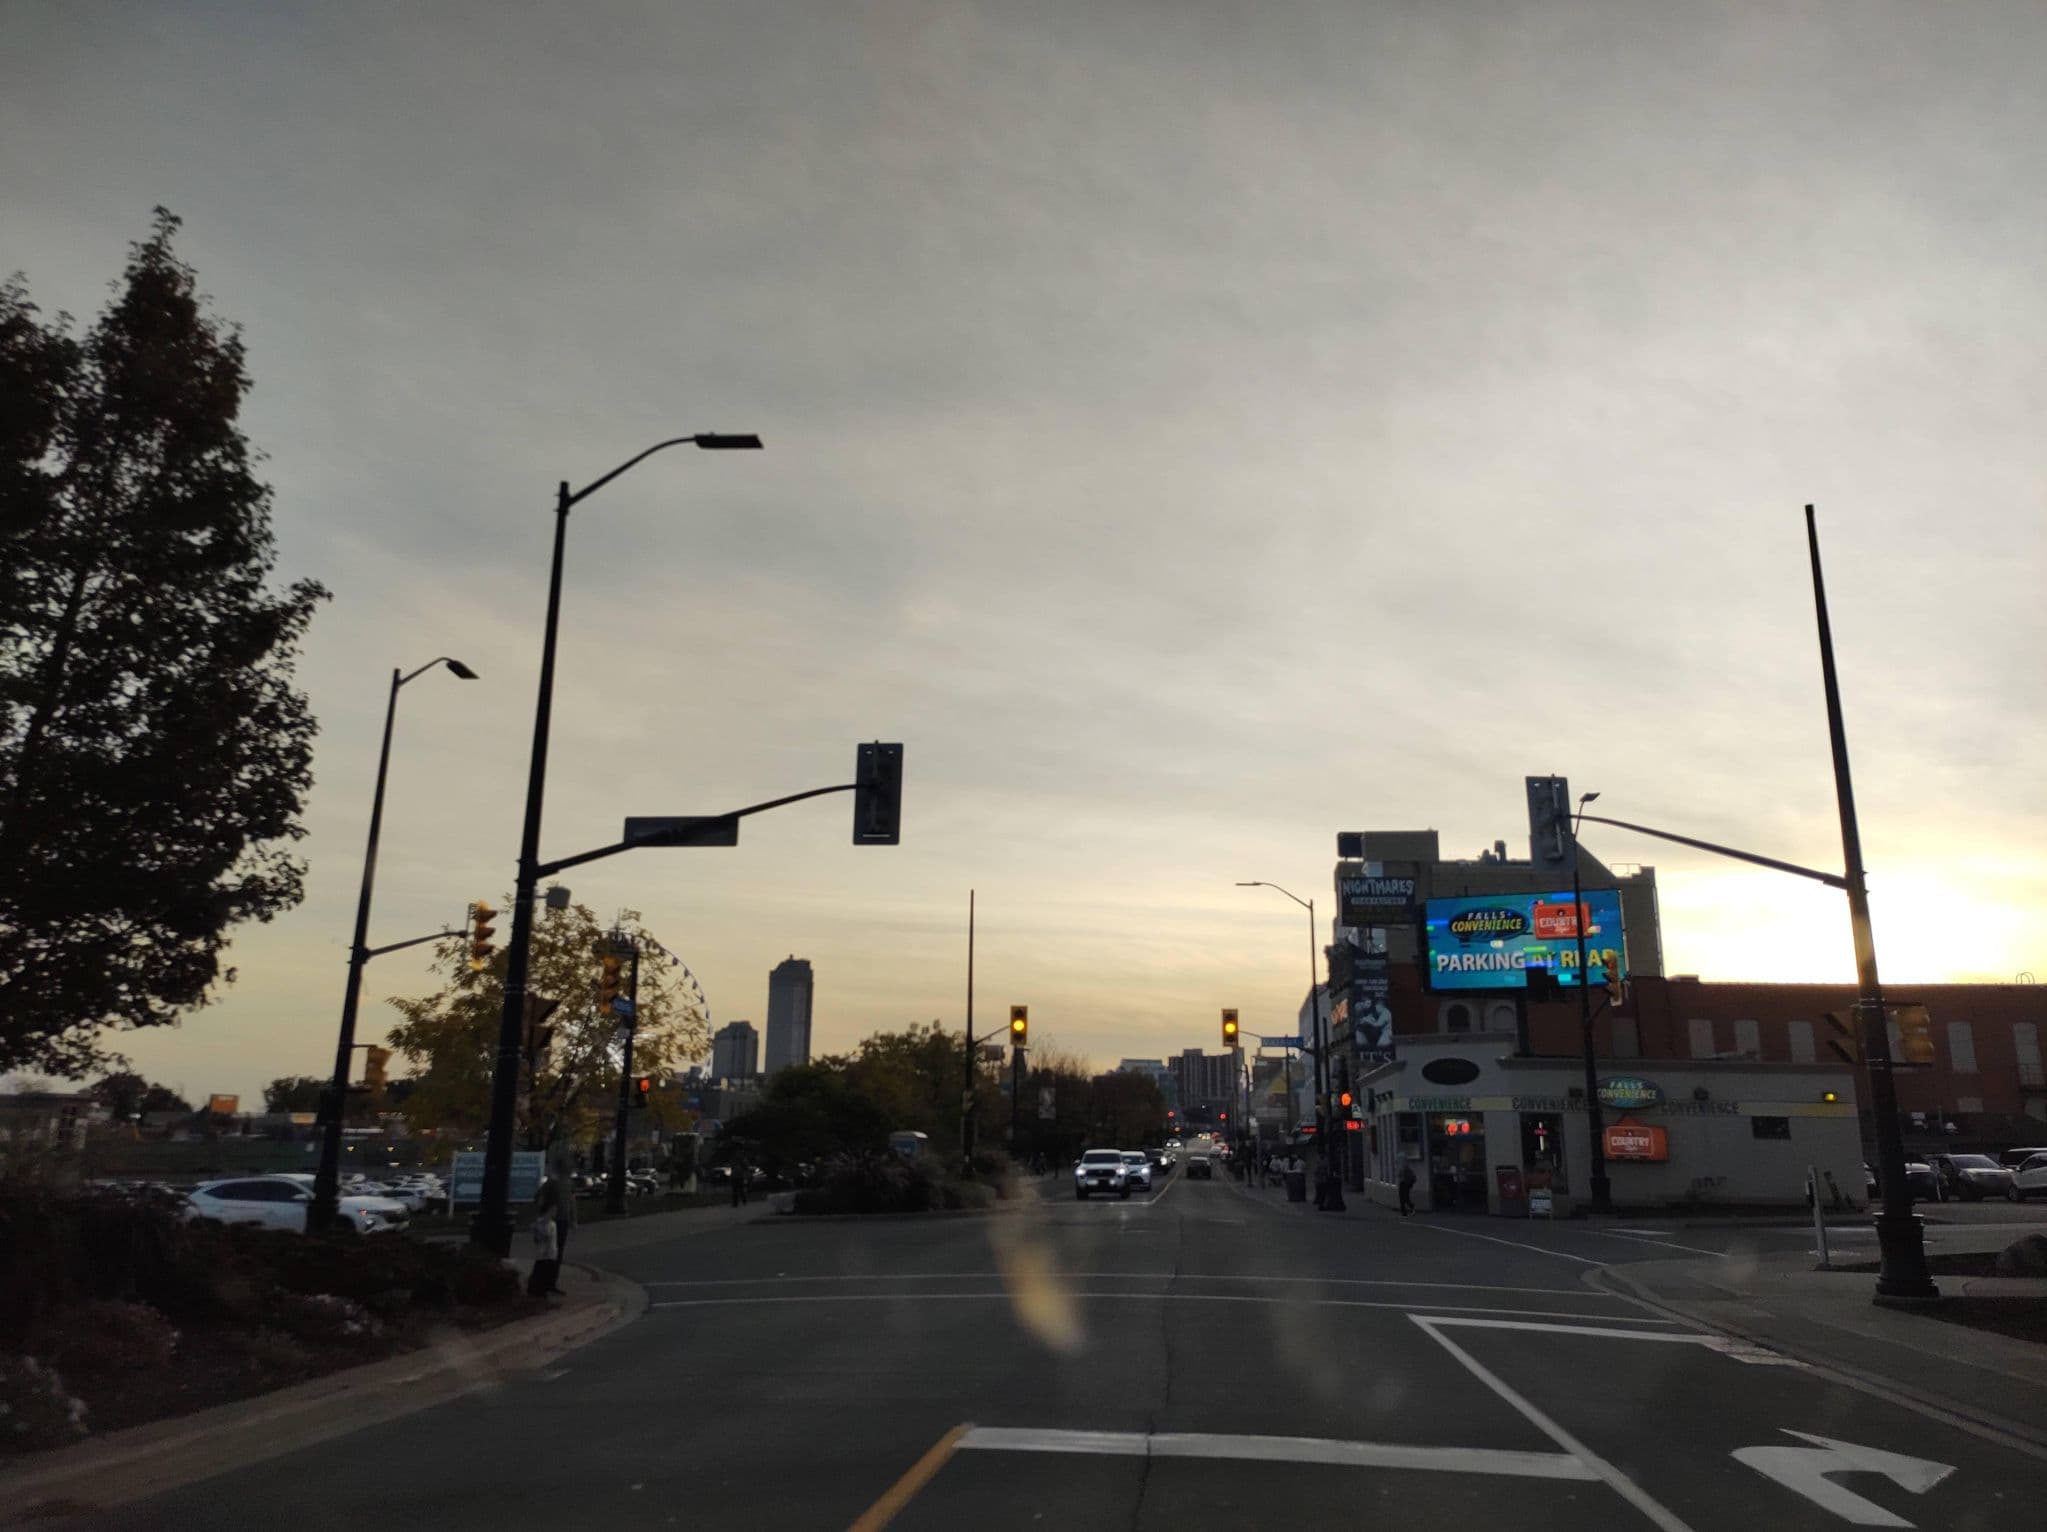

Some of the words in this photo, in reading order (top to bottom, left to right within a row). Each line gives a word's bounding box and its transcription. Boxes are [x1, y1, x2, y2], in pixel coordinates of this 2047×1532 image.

[1343, 879, 1415, 896] NIGHTMARES
[1467, 911, 1506, 920] FALLS
[1450, 918, 1522, 932] CONVENIENCE
[1437, 951, 1526, 972] PARKING
[1610, 1080, 1644, 1089] FALLS
[1598, 1088, 1657, 1100] CONVENIENCE
[1409, 1096, 1471, 1110] CONVENIENCE
[1512, 1096, 1588, 1111] CONVENIENCE
[1660, 1102, 1738, 1115] CONVENIENCE
[1611, 1136, 1650, 1147] COUNTRY
